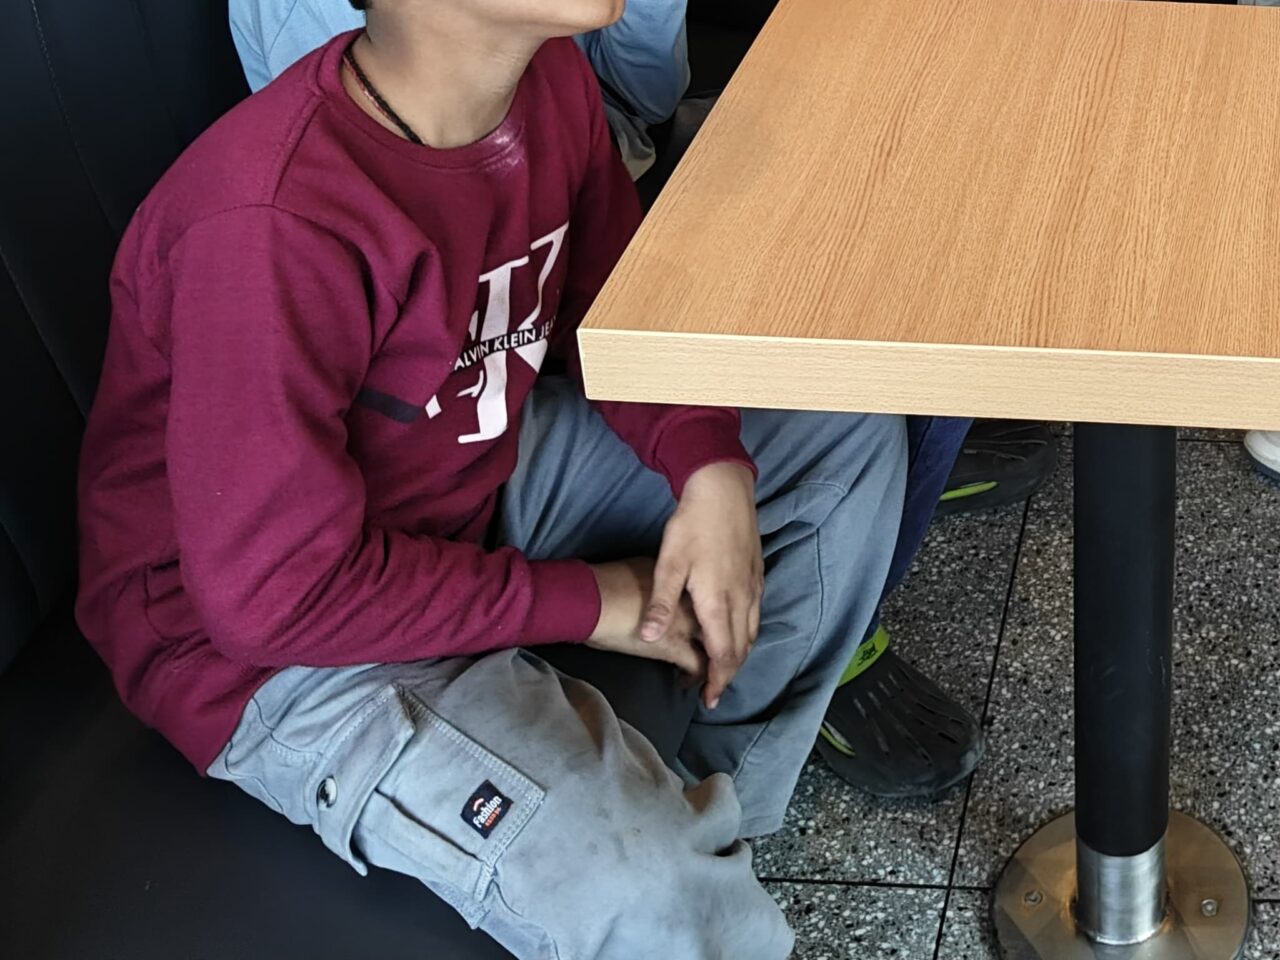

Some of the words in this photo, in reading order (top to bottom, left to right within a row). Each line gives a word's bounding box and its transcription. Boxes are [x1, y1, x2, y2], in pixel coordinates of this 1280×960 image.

[454, 341, 489, 371] ALVIN
[494, 329, 536, 351] KLEIN
[472, 795, 502, 828] Fashion
